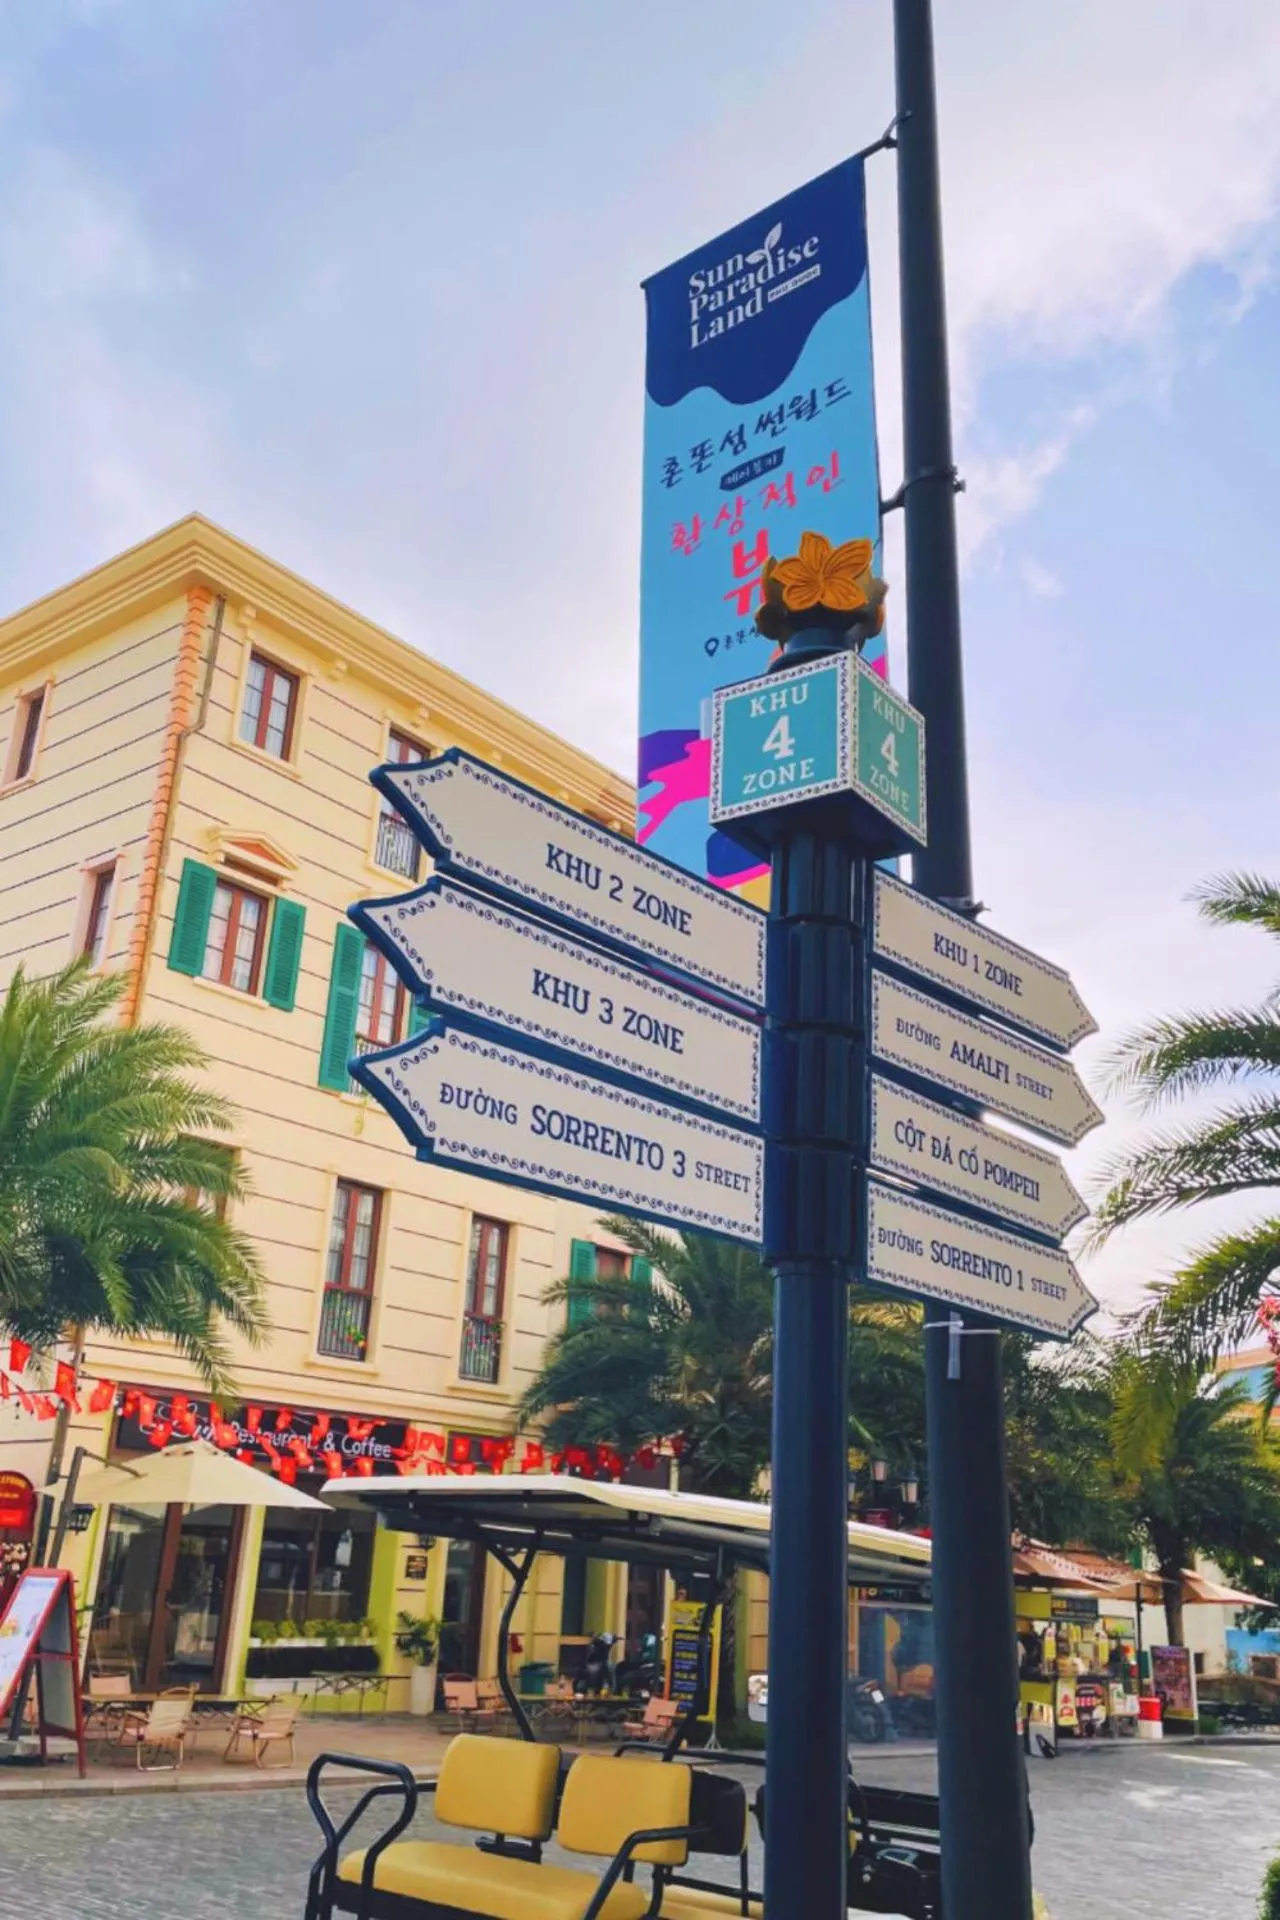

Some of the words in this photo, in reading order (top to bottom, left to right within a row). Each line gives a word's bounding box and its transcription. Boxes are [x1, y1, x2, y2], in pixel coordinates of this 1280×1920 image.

[688, 250, 744, 298] Sun
[689, 234, 820, 324] Paradise
[690, 286, 764, 350] Land
[753, 377, 852, 439] 썬월드
[750, 683, 808, 718] KHU
[872, 690, 906, 735] KHU
[762, 715, 795, 760] 4
[880, 731, 899, 778] 4
[743, 758, 815, 794] ZONE
[869, 764, 911, 813] ZONE
[545, 842, 602, 891] KHU
[608, 874, 624, 903] 2
[632, 886, 692, 936] ZONE
[933, 932, 968, 967] KHU
[973, 954, 979, 974] 1
[984, 960, 1023, 997] ZONE
[531, 968, 591, 1015] KHU
[598, 998, 613, 1025] 3
[622, 1006, 684, 1055] ZONE
[949, 1040, 1010, 1084] AMALFI
[1016, 1072, 1054, 1101] STREET
[439, 1082, 518, 1125] ĐƯỜNG
[530, 1104, 664, 1171] SORRENTO
[672, 1150, 686, 1178] 3
[695, 1161, 751, 1193] STREET
[894, 1117, 926, 1153] CỘT
[931, 1135, 954, 1166] ĐÁ
[984, 1159, 1040, 1202] POMPEII
[931, 1240, 1012, 1287] SORRENTO
[1018, 1270, 1024, 1291] 1
[1031, 1277, 1067, 1301] STREET
[323, 1431, 335, 1452] &
[341, 1432, 392, 1458] Coffee
